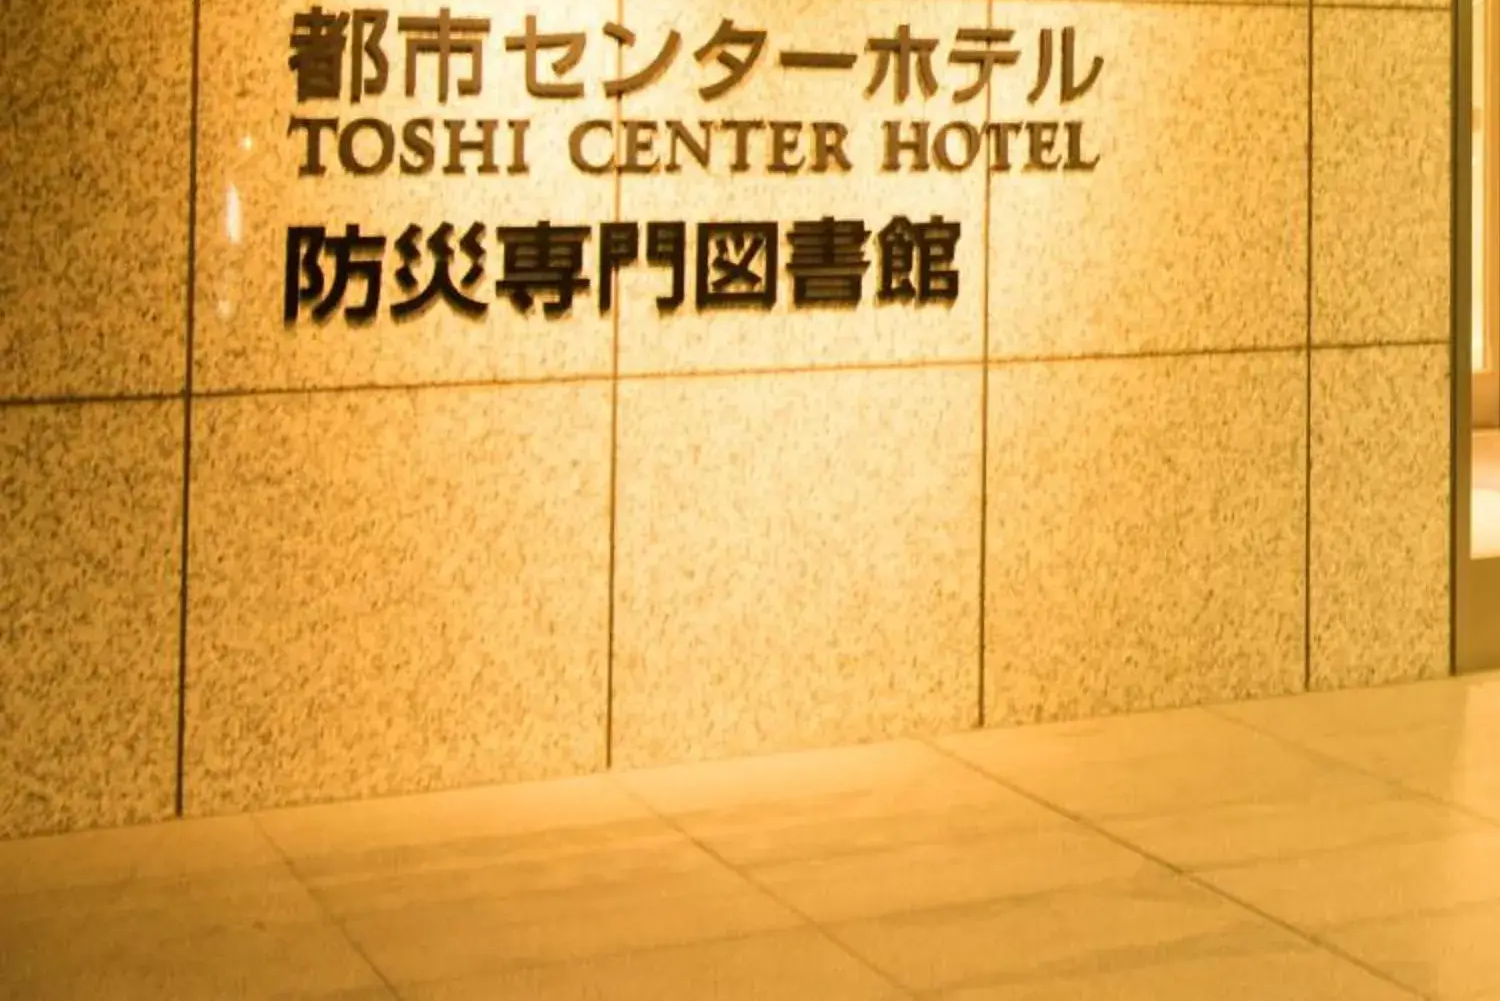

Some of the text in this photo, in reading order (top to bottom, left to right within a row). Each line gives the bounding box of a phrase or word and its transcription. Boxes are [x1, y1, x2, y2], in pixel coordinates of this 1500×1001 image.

[288, 6, 1105, 105] 都市センターホテル
[287, 116, 1101, 176] TOSHI CENTER HOTEL
[284, 215, 961, 327] 防災専門図書館
